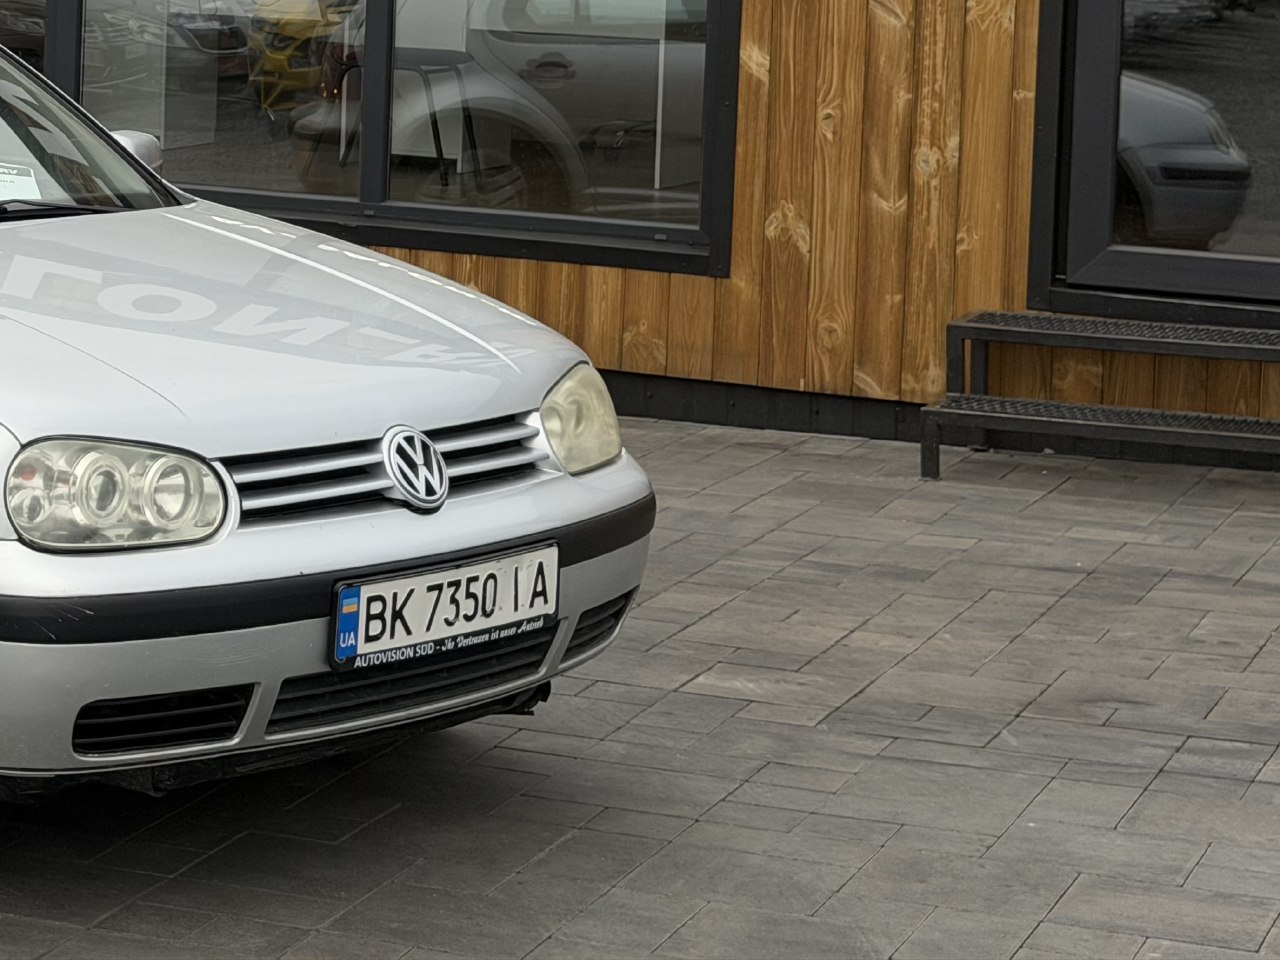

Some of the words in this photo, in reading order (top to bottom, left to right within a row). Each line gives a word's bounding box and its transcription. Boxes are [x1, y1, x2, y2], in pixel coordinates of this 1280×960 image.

[364, 588, 415, 644] BK
[425, 572, 498, 633] 7350
[339, 632, 356, 648] UA
[354, 647, 414, 669] AUTOVISION
